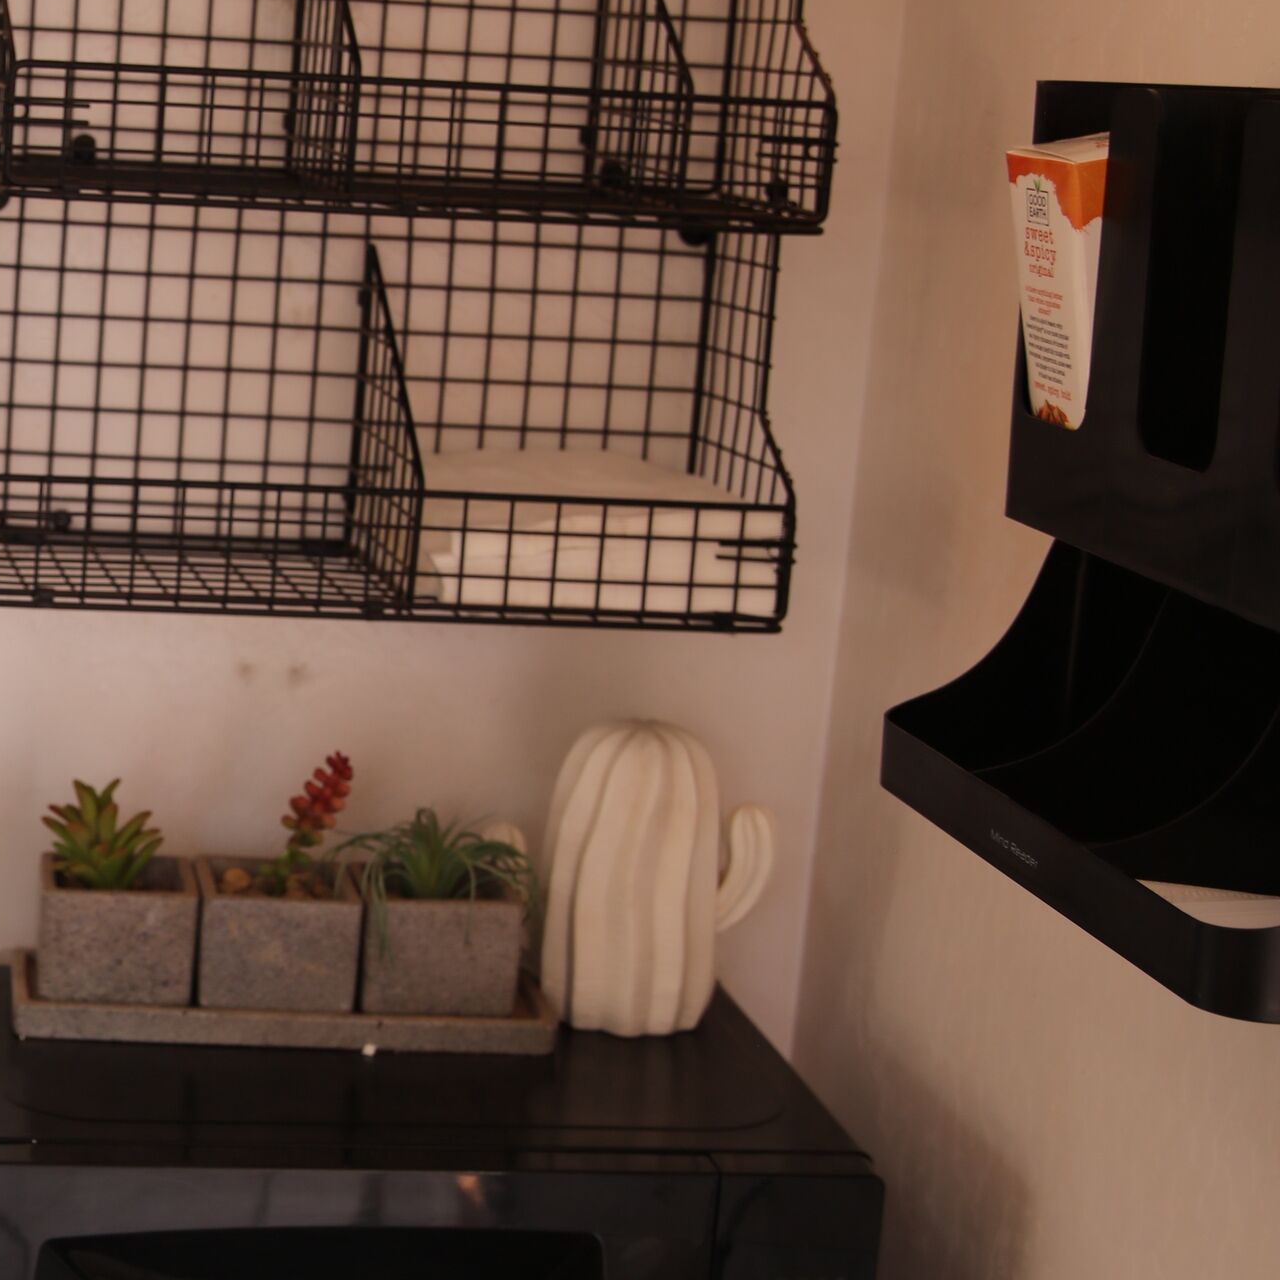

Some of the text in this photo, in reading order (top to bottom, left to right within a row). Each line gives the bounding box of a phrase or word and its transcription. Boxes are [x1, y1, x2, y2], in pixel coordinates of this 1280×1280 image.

[1029, 193, 1047, 208] GOOD
[1029, 206, 1047, 218] EARTH
[1025, 227, 1054, 245] sweet
